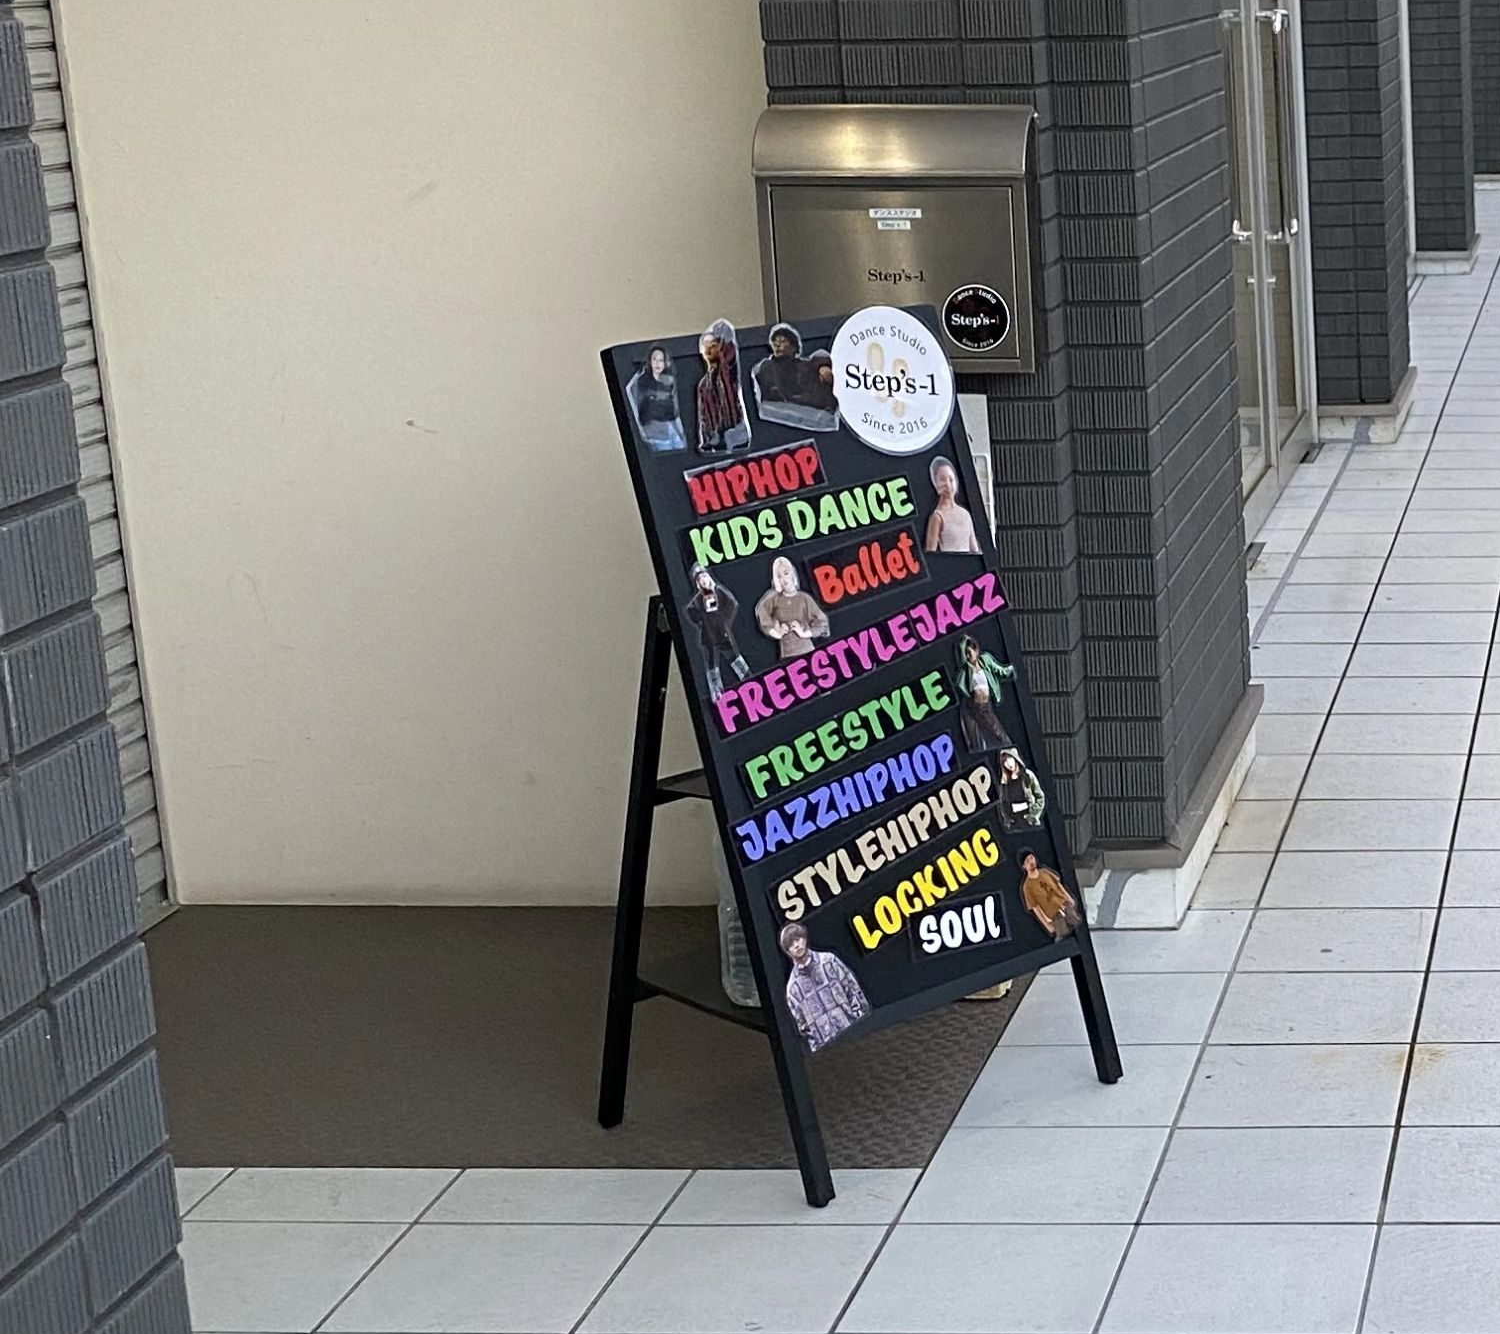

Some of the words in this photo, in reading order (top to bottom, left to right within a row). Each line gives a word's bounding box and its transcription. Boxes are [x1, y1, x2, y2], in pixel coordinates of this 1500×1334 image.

[868, 269, 926, 284] Step's-1
[849, 326, 885, 346] Dance
[890, 326, 927, 355] Studio
[951, 313, 1000, 328] Step's-1
[845, 363, 939, 397] Step's-1
[862, 412, 894, 433] Since
[899, 417, 928, 434] 2016
[687, 446, 819, 514] HIPHOP
[689, 509, 784, 567] KIDS
[787, 477, 915, 540] DANCE
[814, 531, 920, 604] Ballet
[717, 572, 1005, 733] FREESTYLEJAZZ
[745, 671, 950, 799] FREESTYLE
[736, 734, 954, 861] JAZZHIPHOP
[777, 766, 992, 921] STYLEHIPHOP
[852, 828, 999, 949] LOCKING
